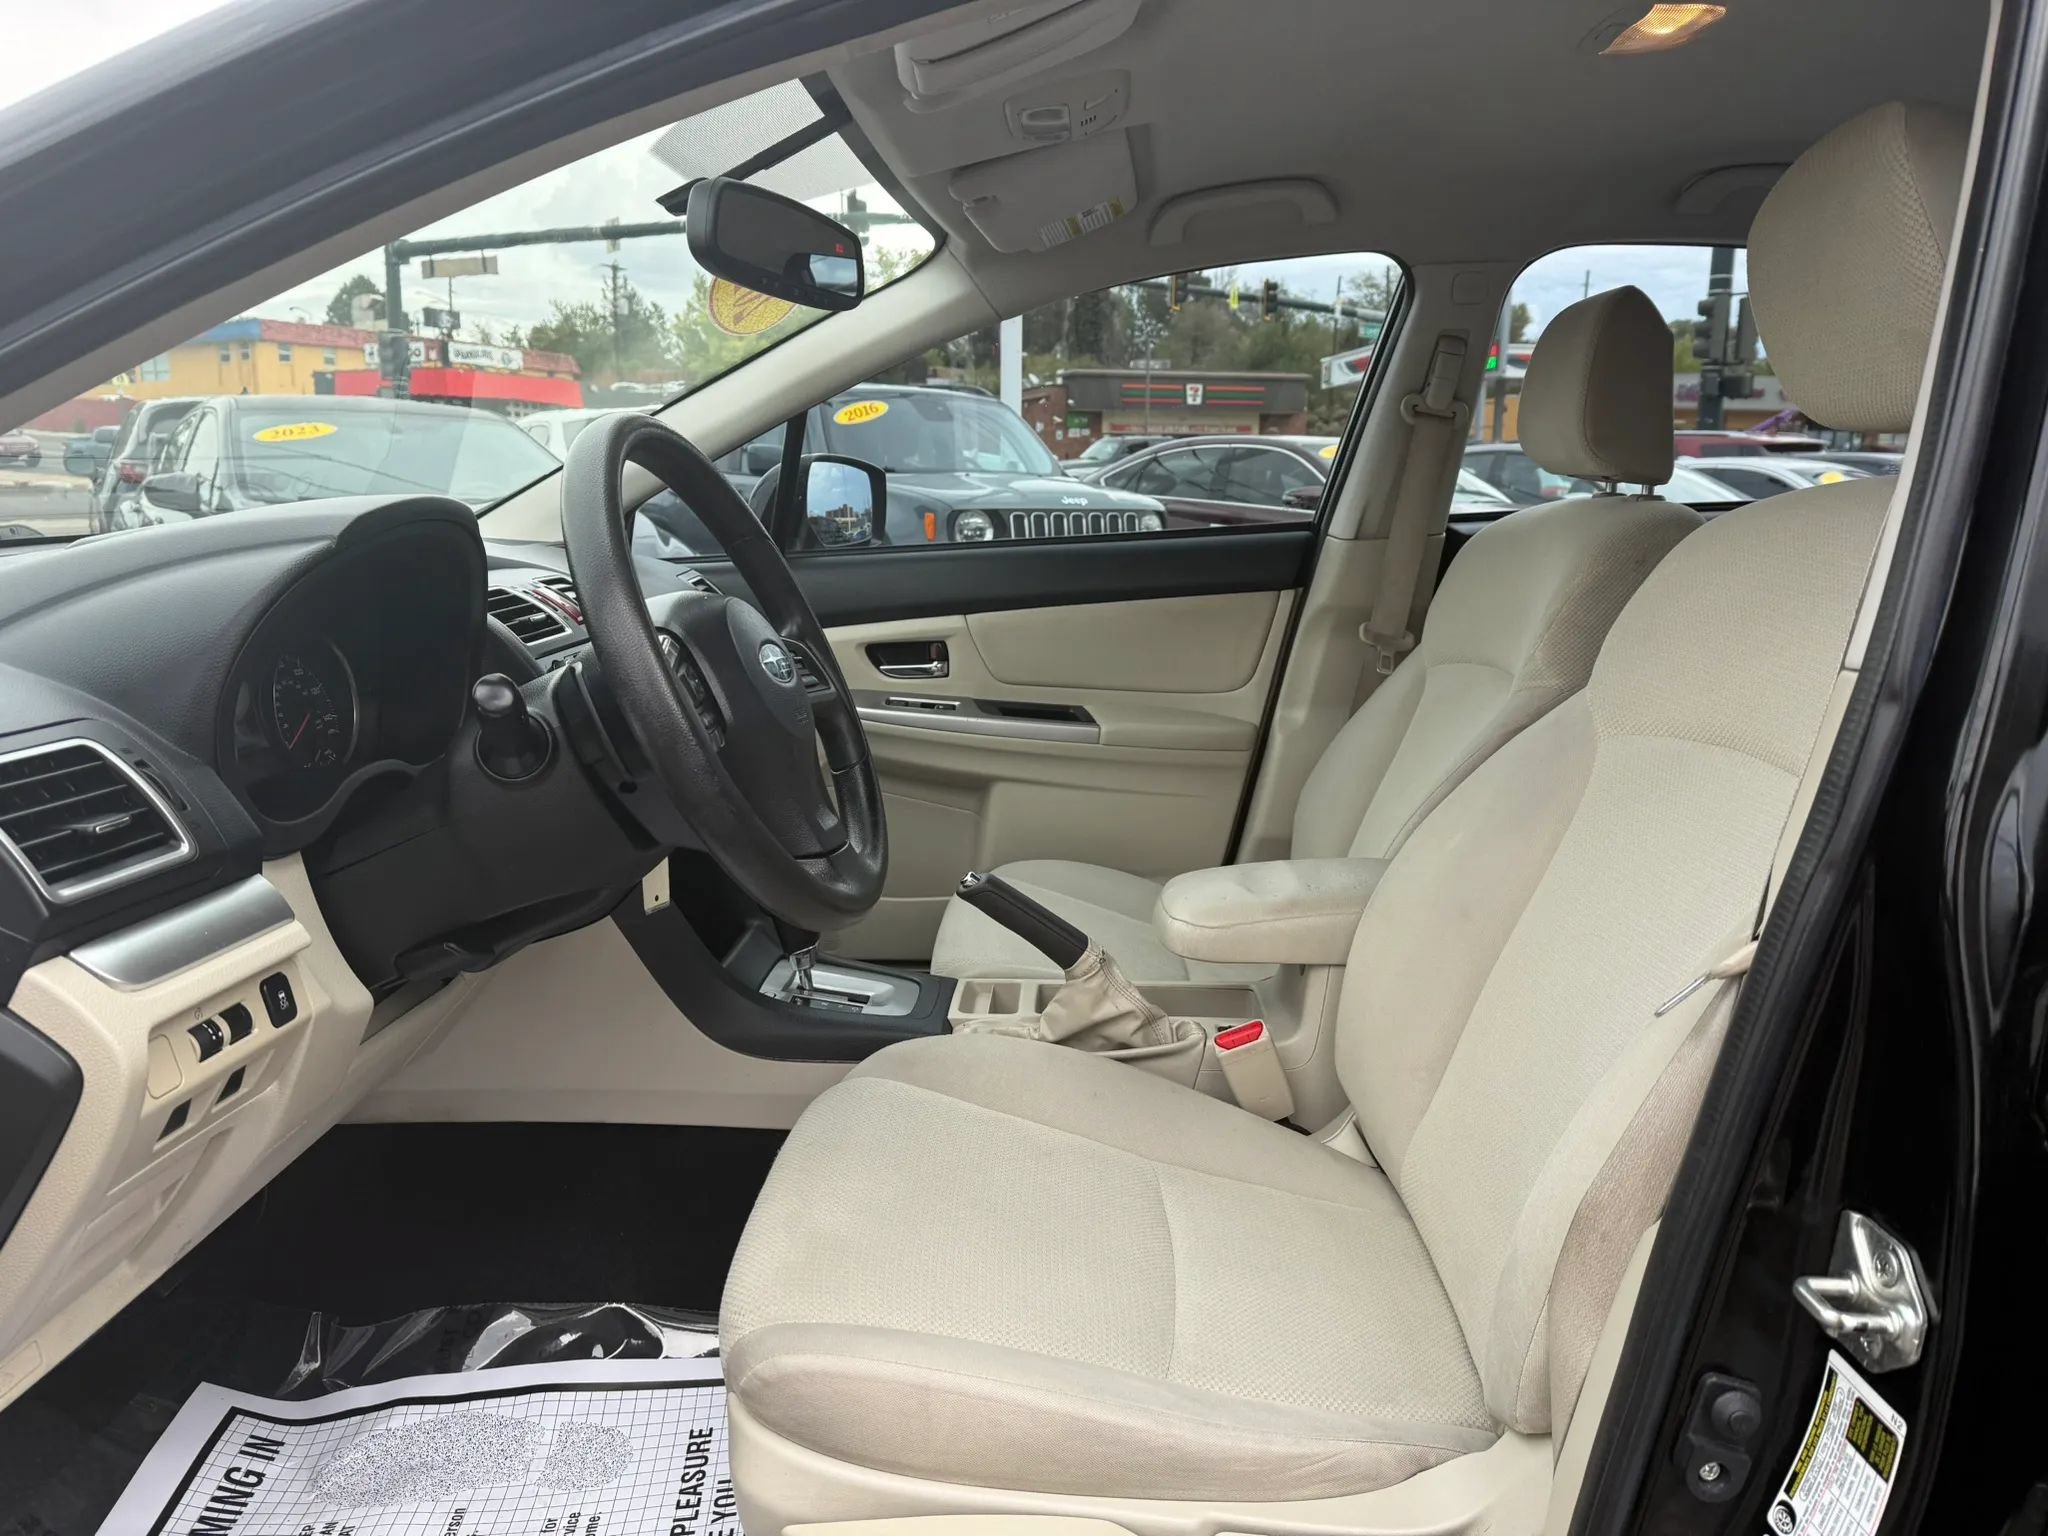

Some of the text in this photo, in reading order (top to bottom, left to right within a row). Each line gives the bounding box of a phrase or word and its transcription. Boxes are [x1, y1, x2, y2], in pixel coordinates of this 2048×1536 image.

[844, 403, 879, 421] 2016
[1061, 496, 1088, 506] Jeep
[238, 1434, 286, 1461] IN
[670, 1427, 713, 1536] PLEASURE
[540, 1518, 558, 1533] for
